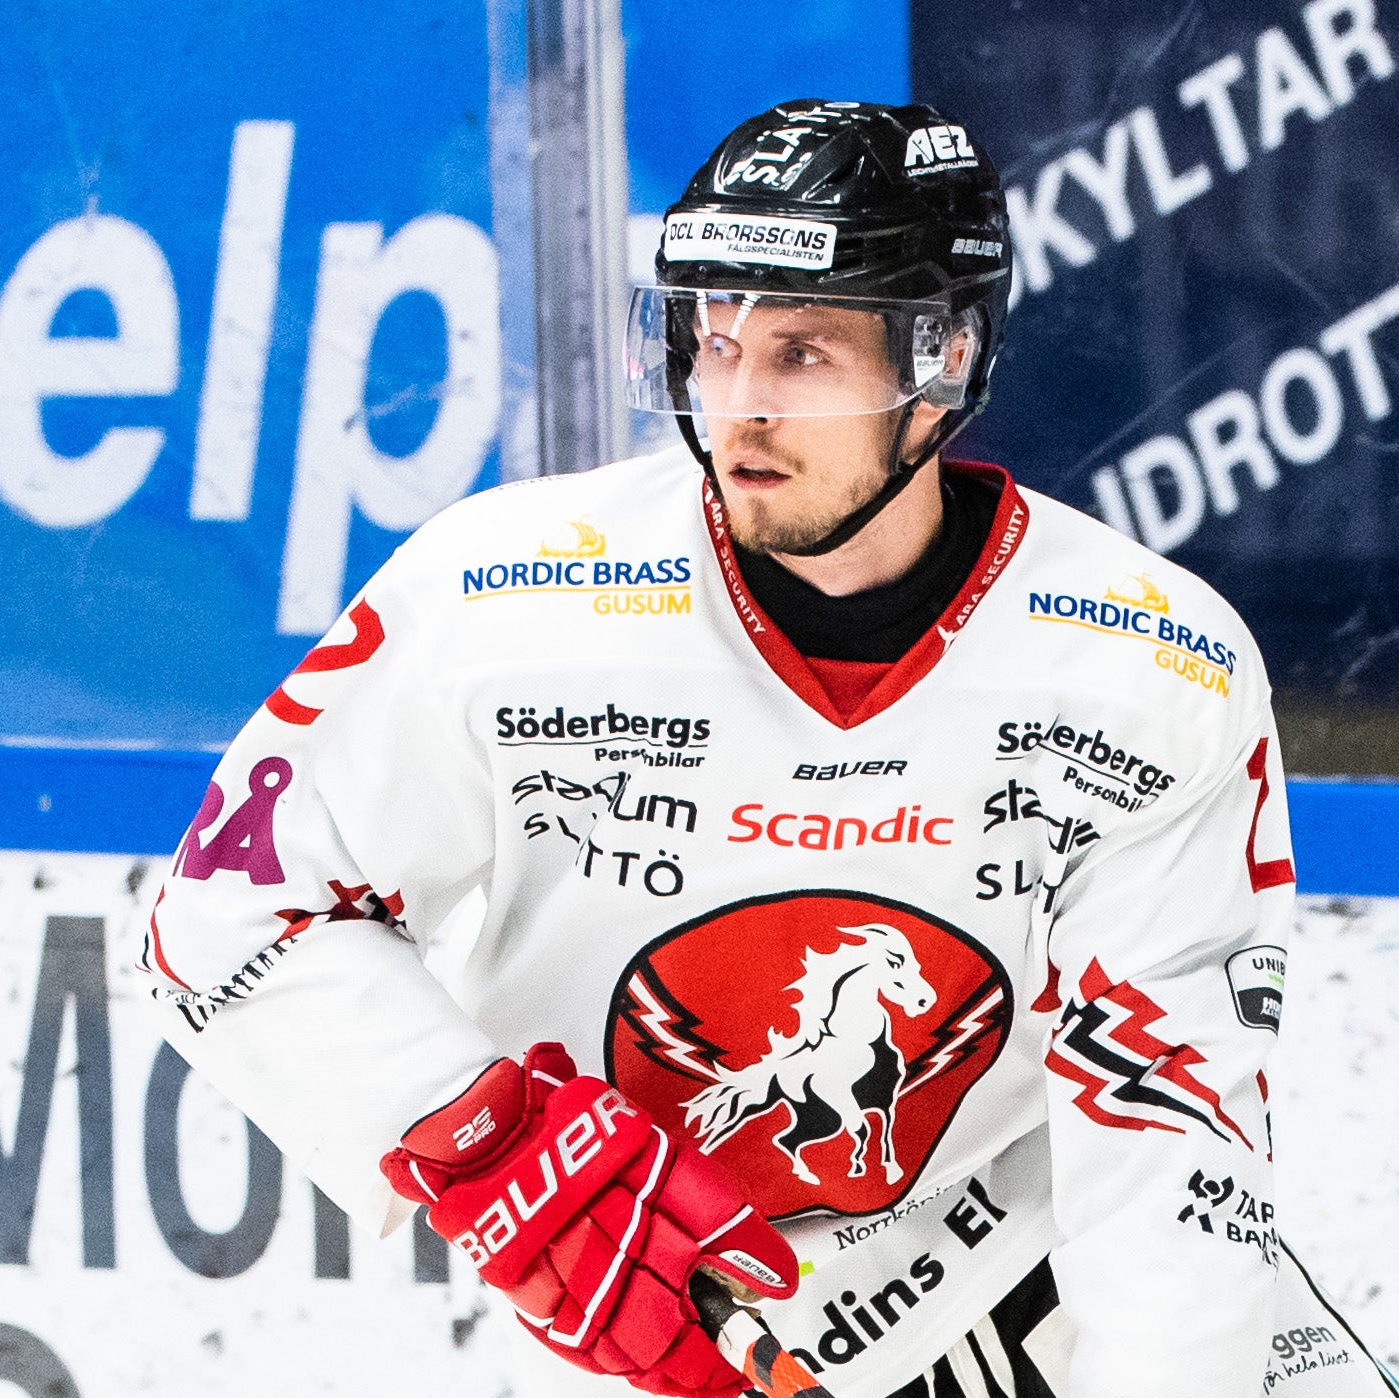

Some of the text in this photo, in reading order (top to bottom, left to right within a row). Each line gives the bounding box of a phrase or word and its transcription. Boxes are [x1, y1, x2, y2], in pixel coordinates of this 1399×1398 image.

[1006, 0, 1397, 312] KYLTAR
[981, 504, 1025, 585] SECURITY
[463, 556, 691, 595] NORDIC BRASS
[593, 592, 691, 615] GUSUM
[1029, 592, 1237, 676] NORDIC BRASS
[496, 703, 711, 748] Söderbergs
[727, 803, 954, 851] Scandic
